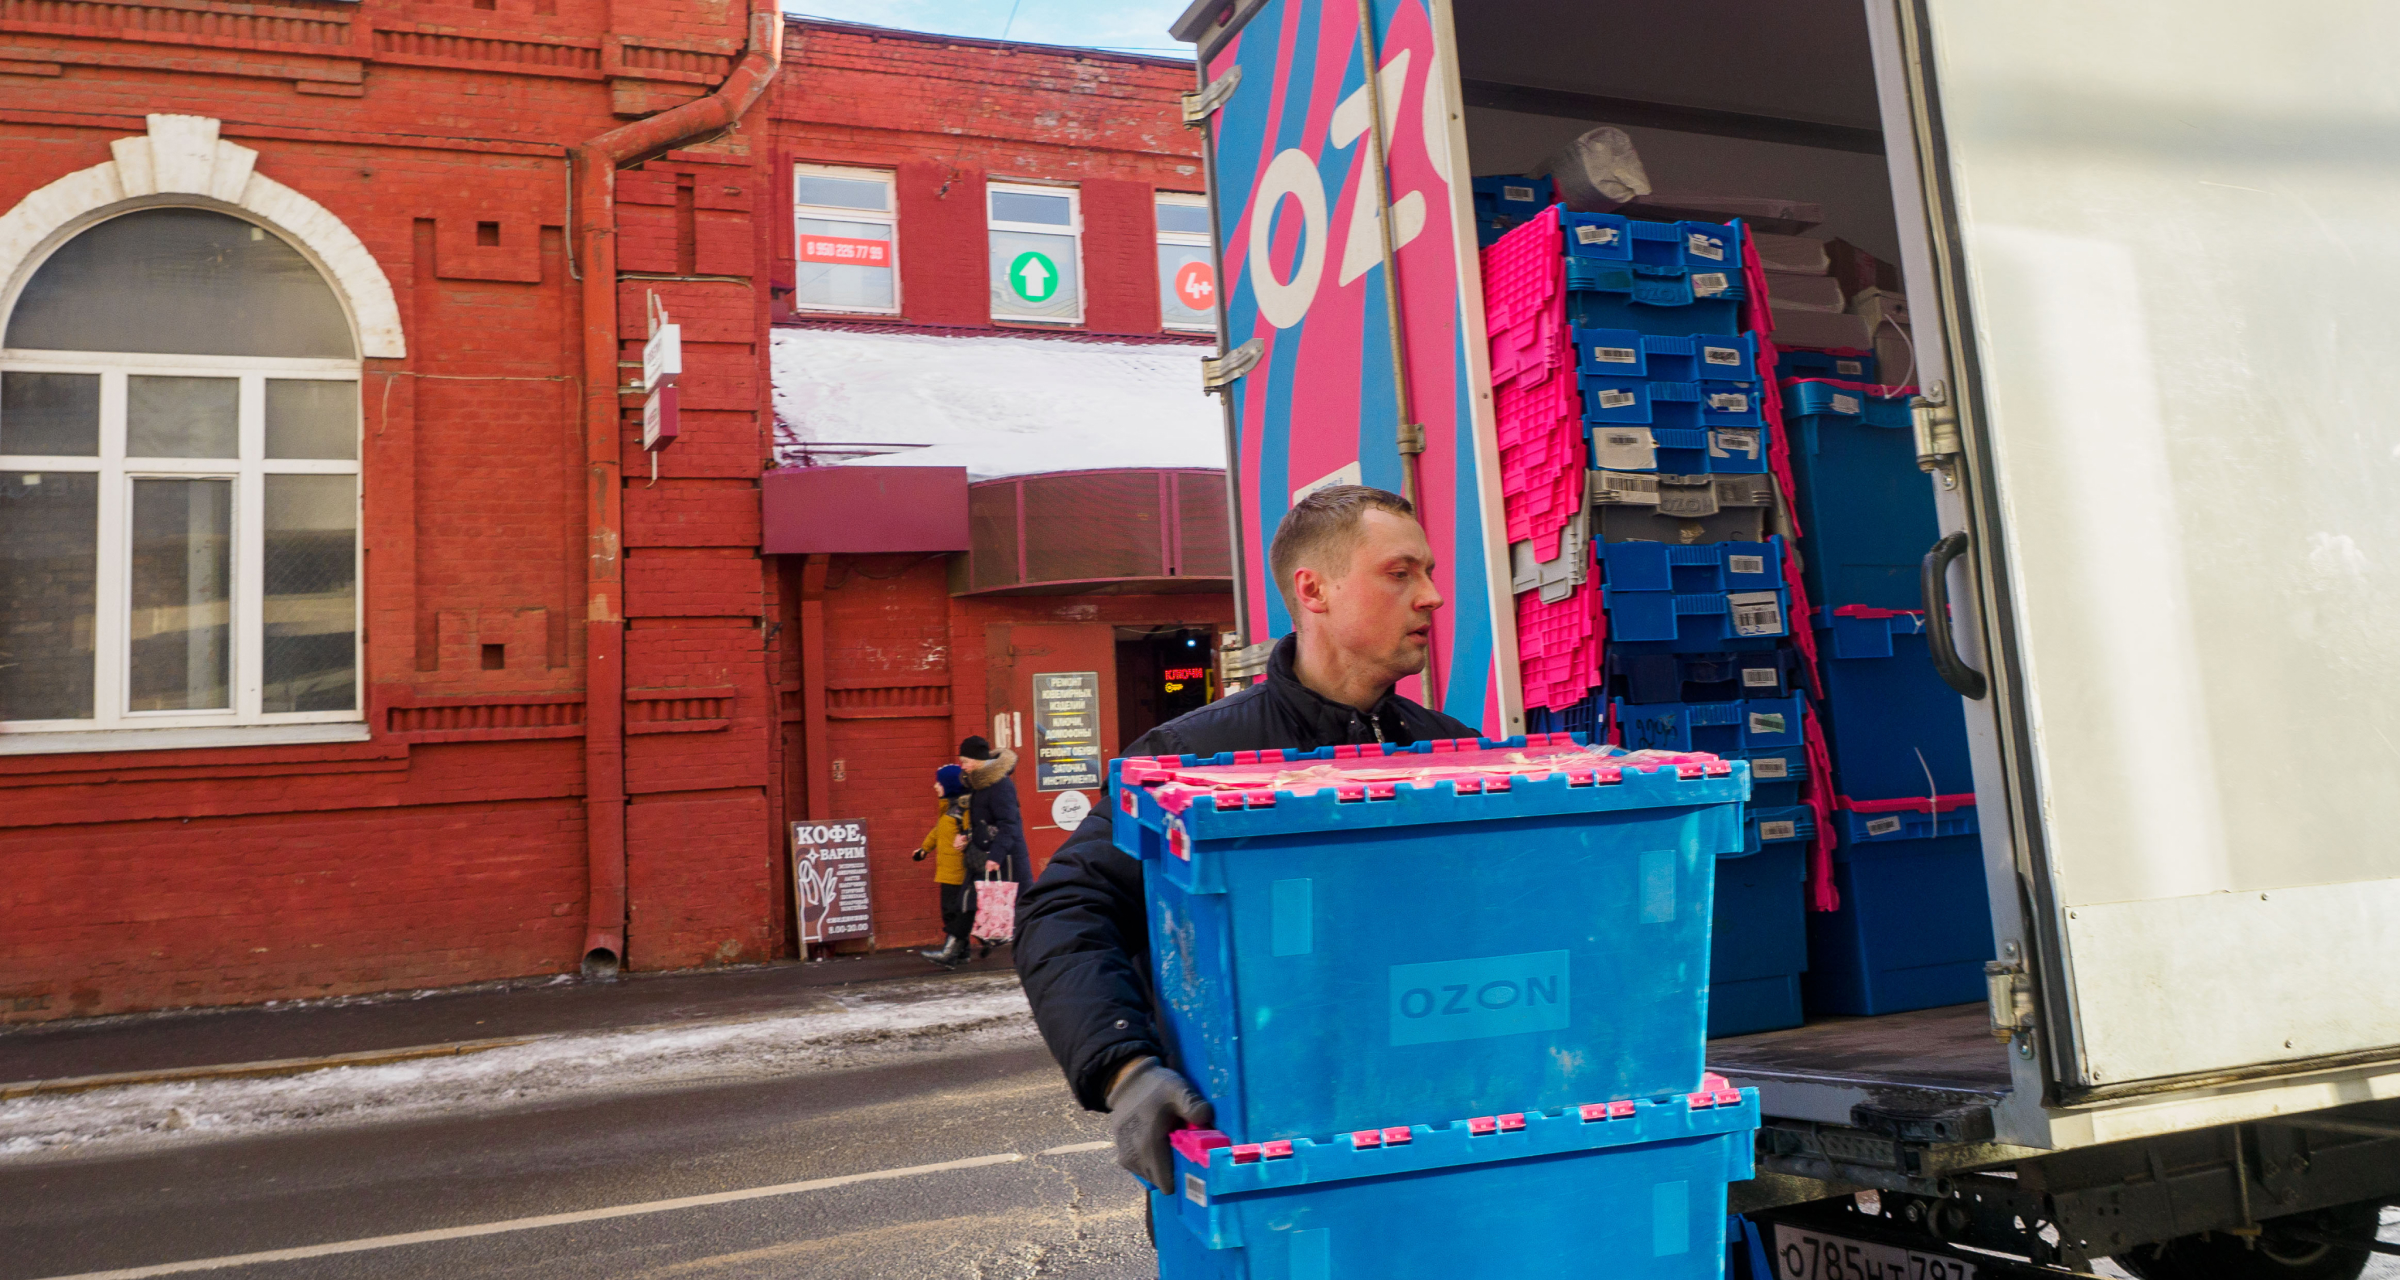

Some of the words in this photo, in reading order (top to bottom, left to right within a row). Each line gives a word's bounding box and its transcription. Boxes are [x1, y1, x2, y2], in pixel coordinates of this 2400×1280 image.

[1185, 272, 1212, 299] 4+
[1165, 668, 1203, 680] КЛЮЧИ
[1051, 677, 1082, 687] РЕМОНТ
[1045, 728, 1092, 740] ДОМОФОНЫ
[1040, 747, 1071, 757] РЕМОНТ
[1052, 763, 1088, 774] ЗАТОЧКА
[1042, 774, 1098, 786] ИНСТРУМЕНТА
[797, 824, 866, 844] КОФЕ,
[820, 847, 865, 860] ВАРИМ
[1401, 974, 1558, 1019] OZON
